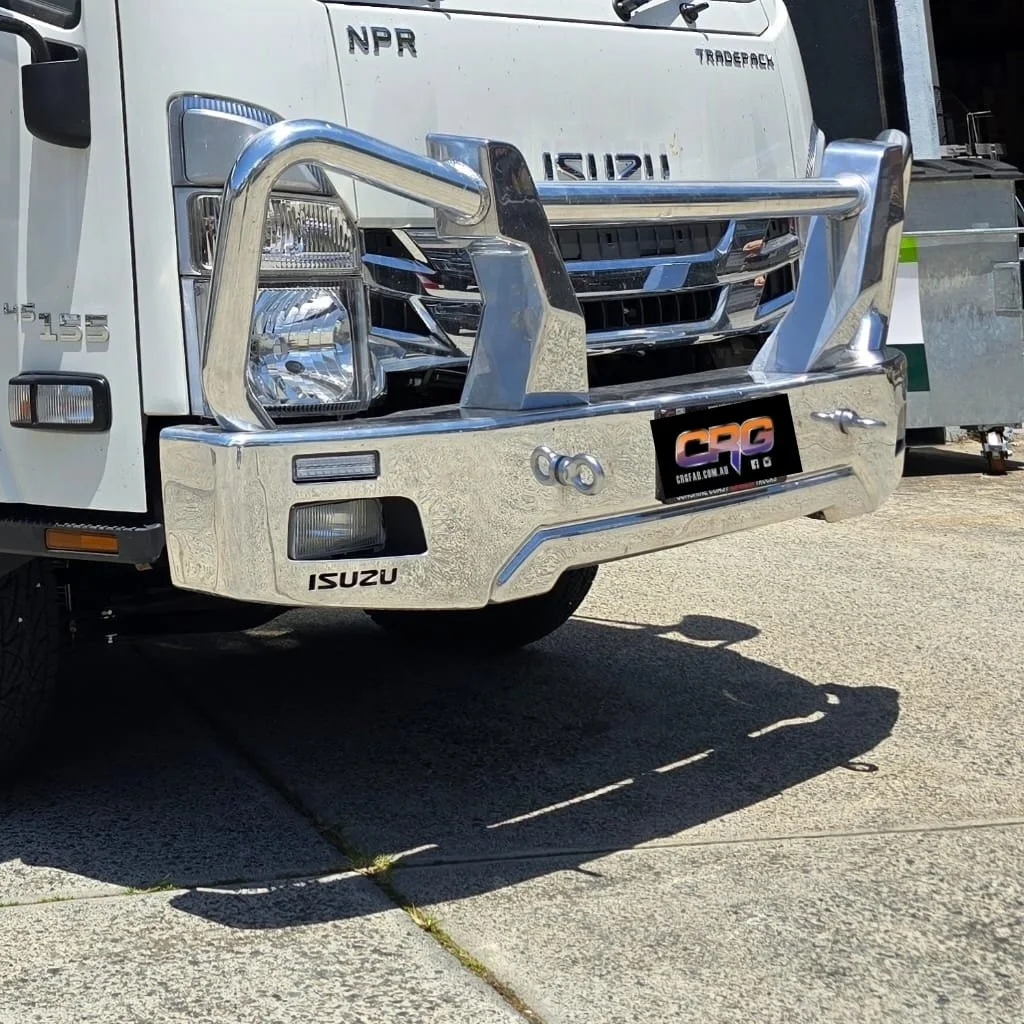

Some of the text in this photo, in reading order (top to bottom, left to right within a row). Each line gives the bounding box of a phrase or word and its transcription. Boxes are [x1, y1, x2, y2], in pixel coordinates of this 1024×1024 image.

[345, 24, 418, 58] NPR
[694, 47, 775, 71] TRADEPACK
[542, 151, 671, 181] ISUZU
[38, 312, 111, 343] 155
[675, 416, 775, 475] CRG
[676, 465, 730, 485] CRGFAB.COM.AU
[308, 567, 398, 591] ISUZU
